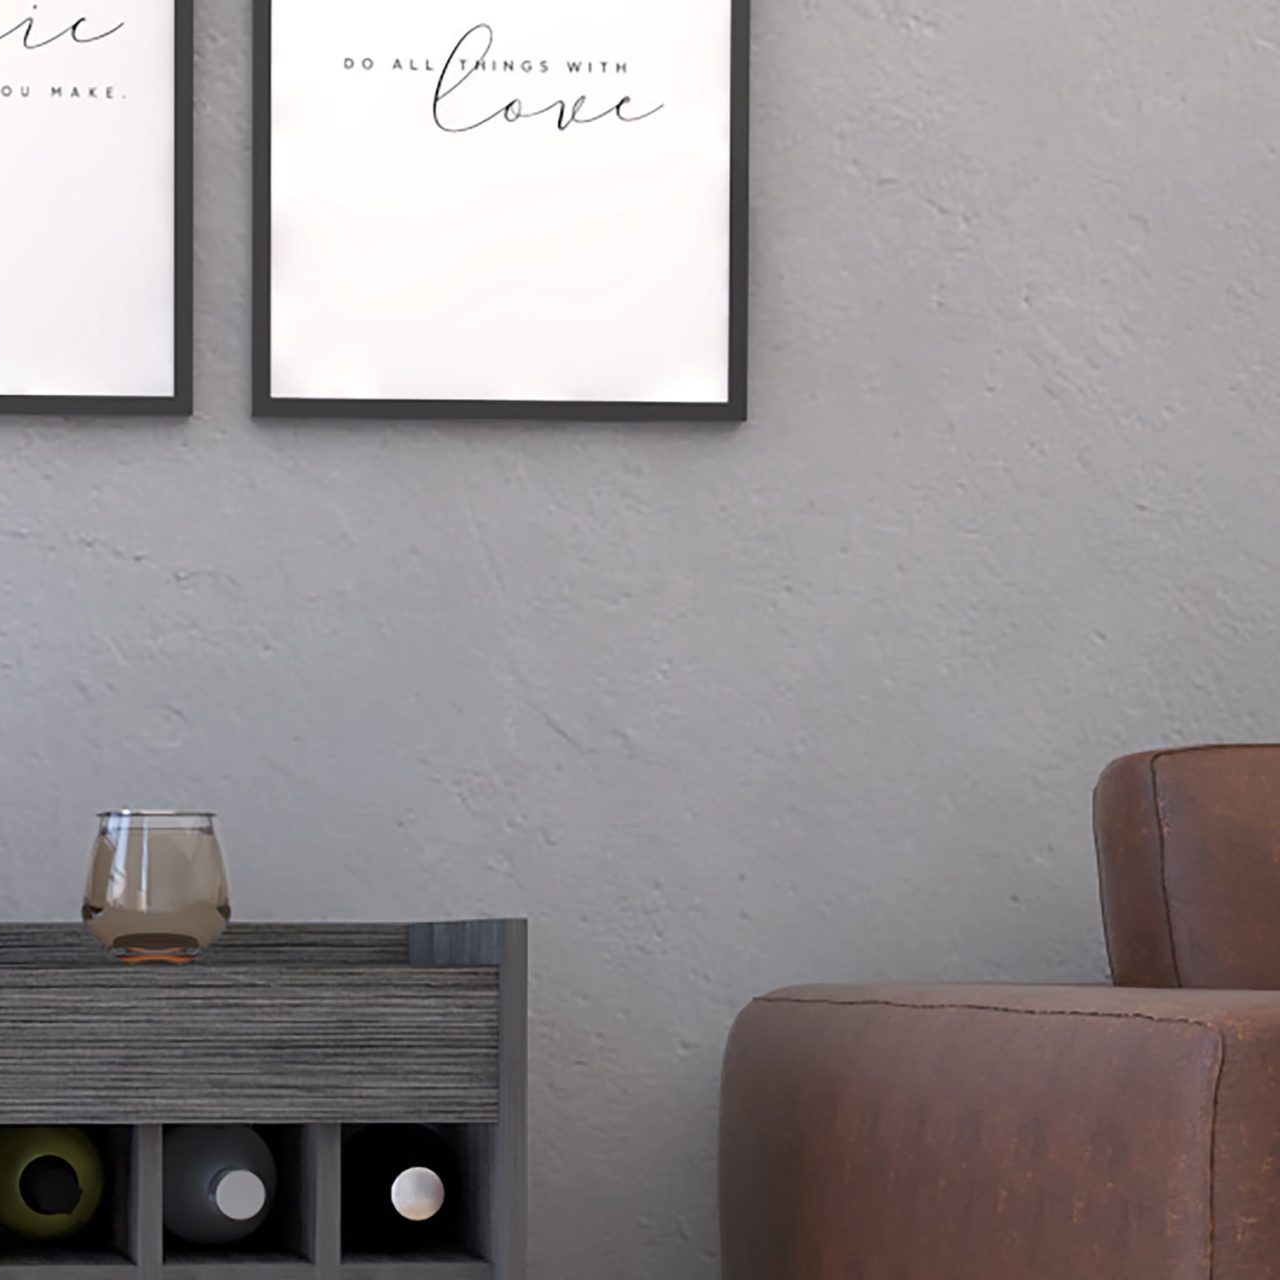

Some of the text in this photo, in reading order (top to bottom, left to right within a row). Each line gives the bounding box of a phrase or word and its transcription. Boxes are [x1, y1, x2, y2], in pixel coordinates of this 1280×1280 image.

[343, 56, 628, 75] DO ALL THINGS WITH
[50, 85, 127, 100] MAKE.
